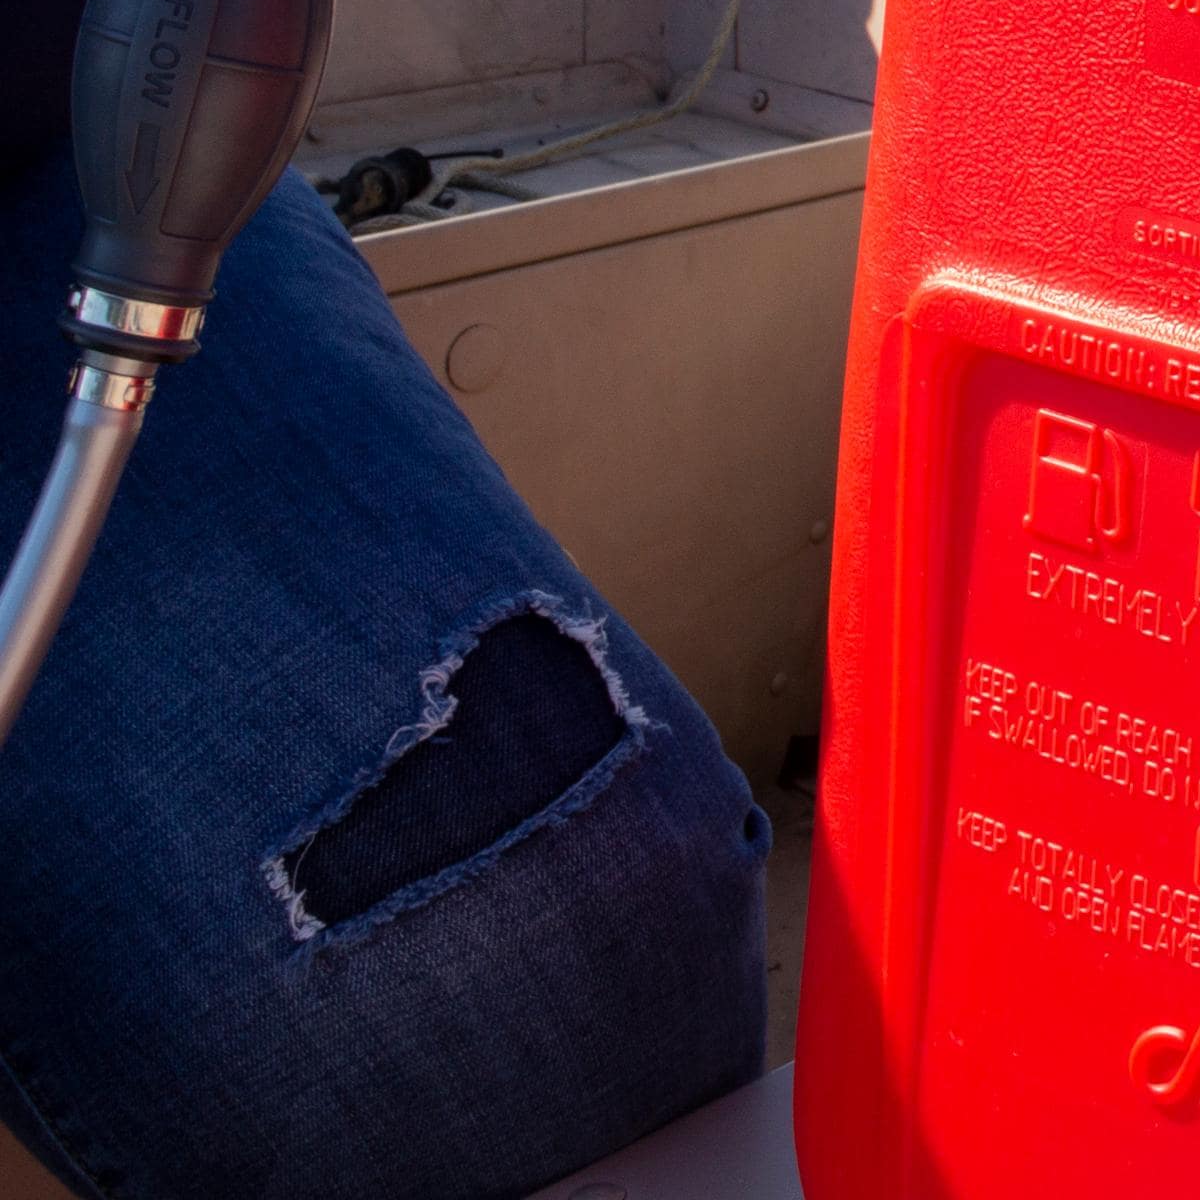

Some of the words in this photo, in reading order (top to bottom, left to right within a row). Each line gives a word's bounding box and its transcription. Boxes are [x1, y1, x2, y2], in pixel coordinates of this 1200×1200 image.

[1021, 319, 1156, 390] CAUTION:
[1027, 552, 1198, 643] EXTREMELY
[964, 658, 1018, 702] KEEP
[1025, 680, 1071, 726] OUT
[1080, 700, 1109, 734] OF
[1117, 712, 1192, 768] REACH
[964, 696, 982, 728] IF
[1143, 760, 1177, 802] DO
[957, 807, 1008, 853] KEEP
[1017, 830, 1124, 896] TOTALLY
[1008, 867, 1053, 912] AND
[1061, 886, 1121, 937] OPEN
